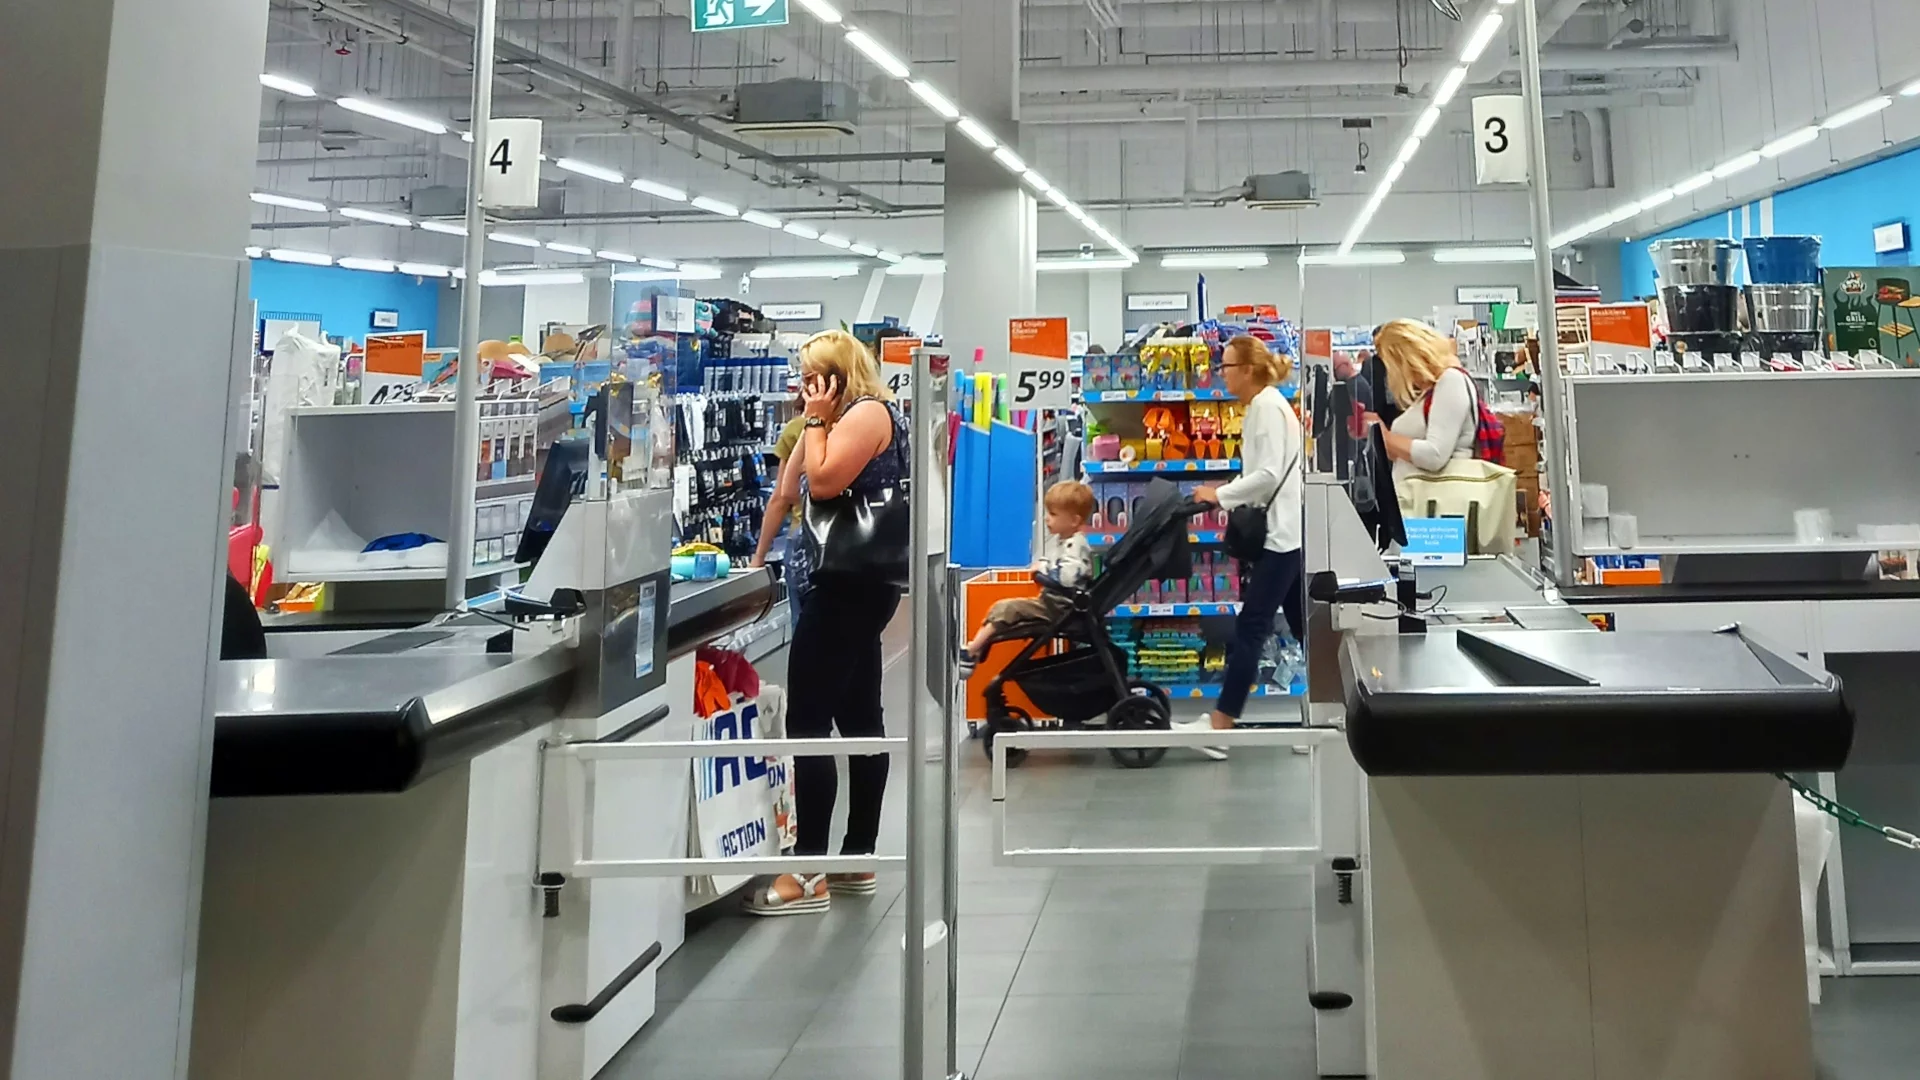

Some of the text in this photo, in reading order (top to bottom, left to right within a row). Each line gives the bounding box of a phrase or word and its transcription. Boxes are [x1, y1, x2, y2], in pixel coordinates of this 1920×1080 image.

[1485, 116, 1508, 153] 3
[490, 138, 512, 174] 4
[887, 373, 911, 394] 43
[1015, 370, 1065, 403] 599
[722, 817, 766, 858] ACTION
